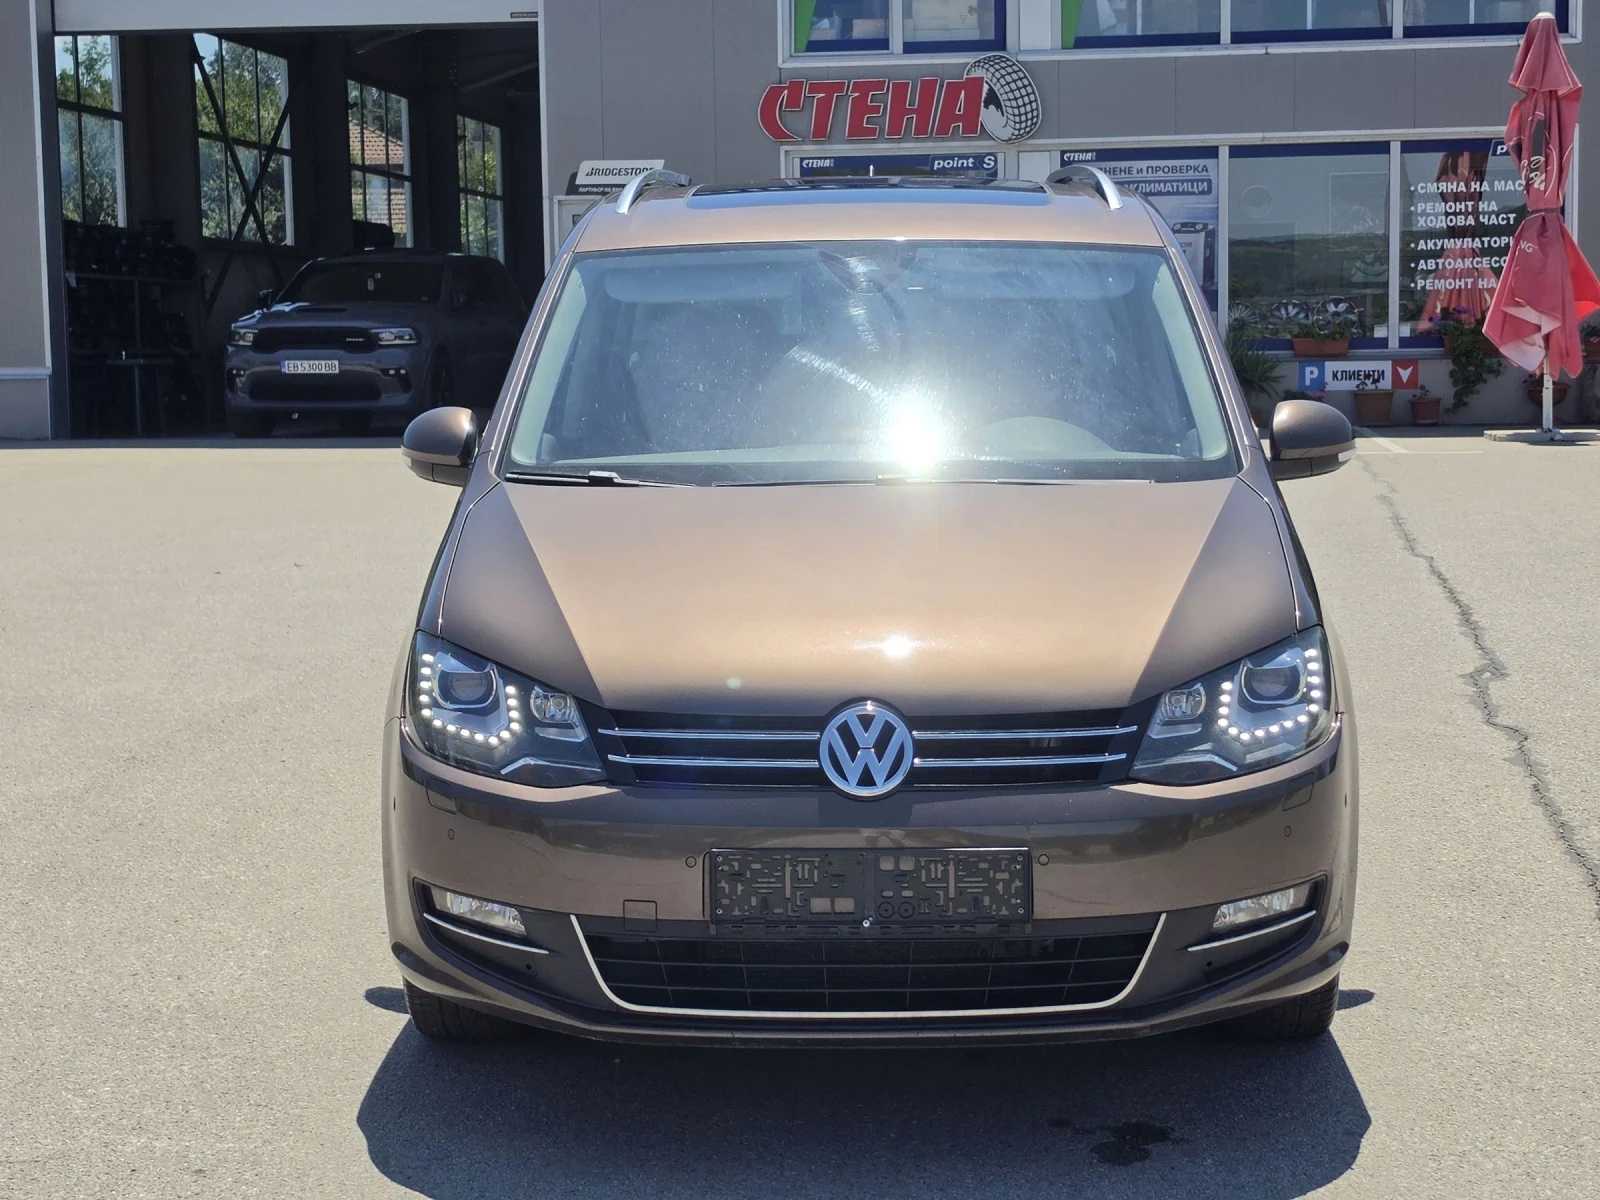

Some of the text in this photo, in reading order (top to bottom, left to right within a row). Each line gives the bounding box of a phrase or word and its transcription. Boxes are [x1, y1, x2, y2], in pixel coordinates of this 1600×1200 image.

[758, 76, 985, 141] СТЕНА
[933, 156, 995, 170] point S
[1146, 164, 1209, 175] ПРОВЕРКА
[1417, 181, 1466, 193] СМЯНА
[1471, 181, 1490, 192] НА
[1417, 201, 1498, 213] РЕМОНТ НА
[1417, 214, 1517, 229] ХОДОВА ЧАСТ
[1417, 278, 1497, 290] РЕМОНТ НА
[1305, 366, 1319, 386] P
